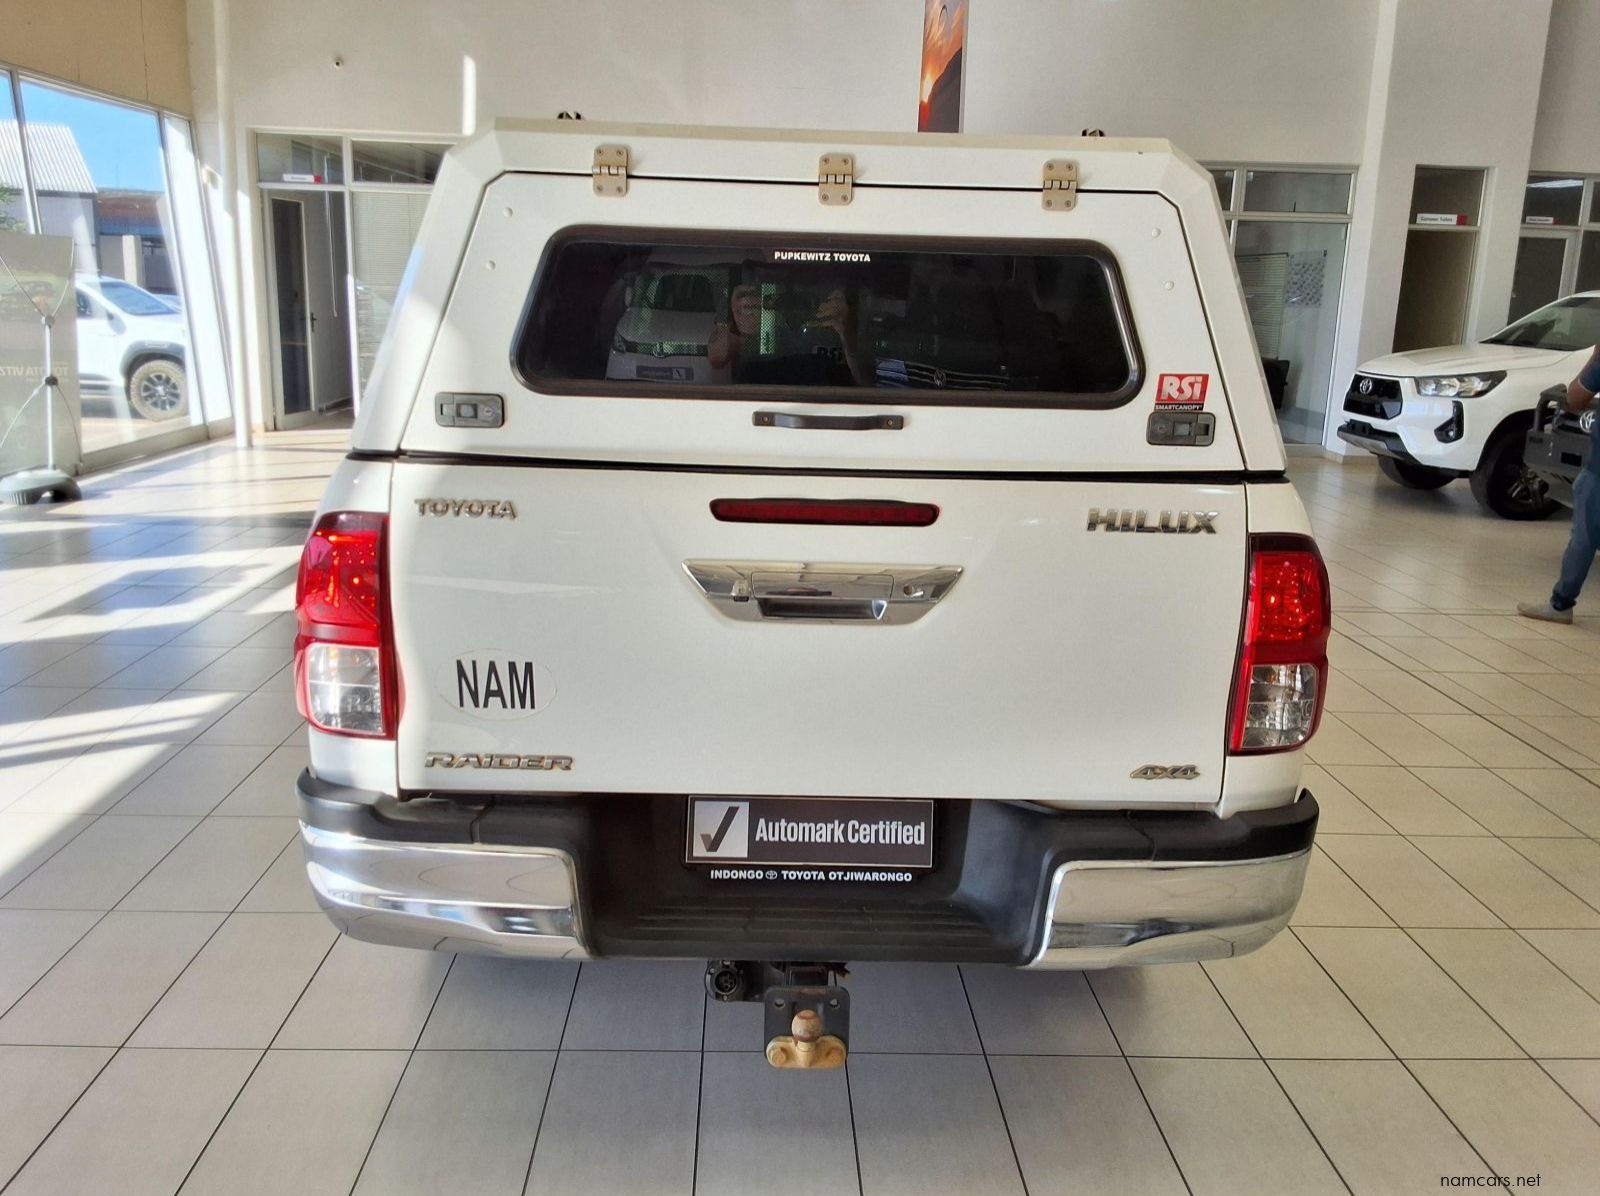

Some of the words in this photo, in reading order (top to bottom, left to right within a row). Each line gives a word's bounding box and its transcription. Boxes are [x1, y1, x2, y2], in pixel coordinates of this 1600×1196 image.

[774, 251, 831, 261] PUPKEWITZ
[833, 253, 871, 262] TOYOTA
[414, 499, 518, 519] TOYOTA
[1087, 508, 1219, 534] HILUX
[456, 659, 536, 710] NAM
[424, 751, 573, 771] RAIDER
[755, 818, 845, 844] Automark
[847, 820, 926, 846] Certified
[710, 870, 764, 881] INDONGO
[781, 870, 826, 882] TOYOTA
[828, 871, 913, 883] OTJIWARONGO
